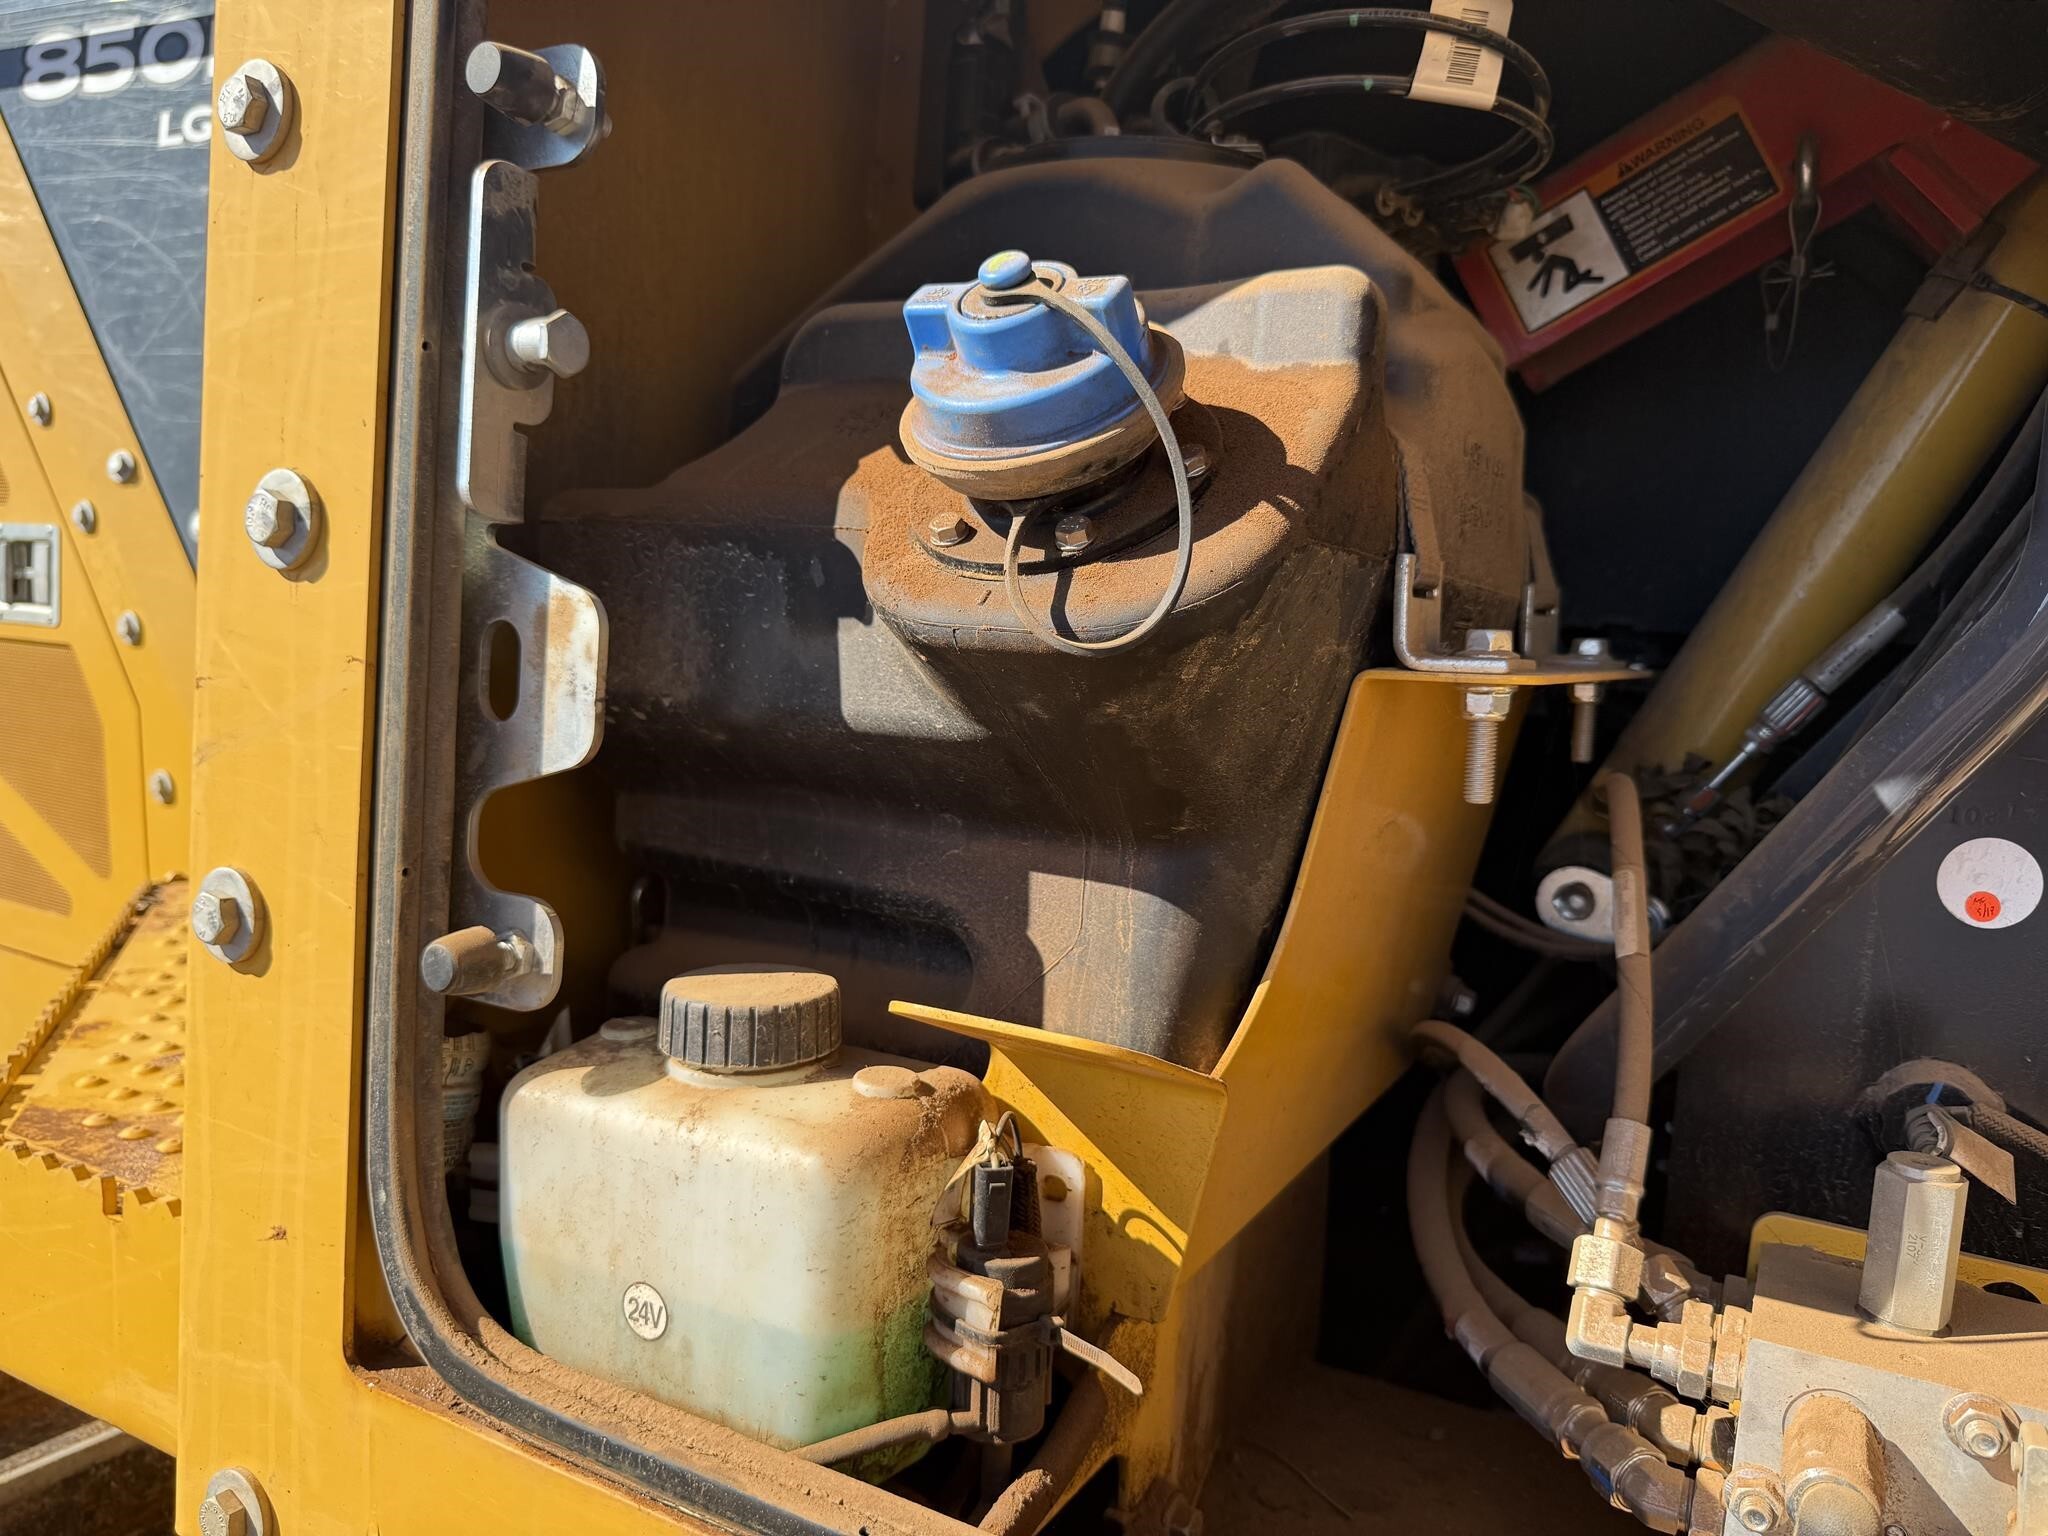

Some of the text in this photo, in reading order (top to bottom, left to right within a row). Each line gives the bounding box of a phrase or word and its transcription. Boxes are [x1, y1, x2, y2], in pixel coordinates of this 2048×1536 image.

[21, 11, 214, 101] 850
[1628, 116, 1706, 168] WARNING
[1906, 1233, 1918, 1259] 2107
[627, 1296, 664, 1329] 24V
